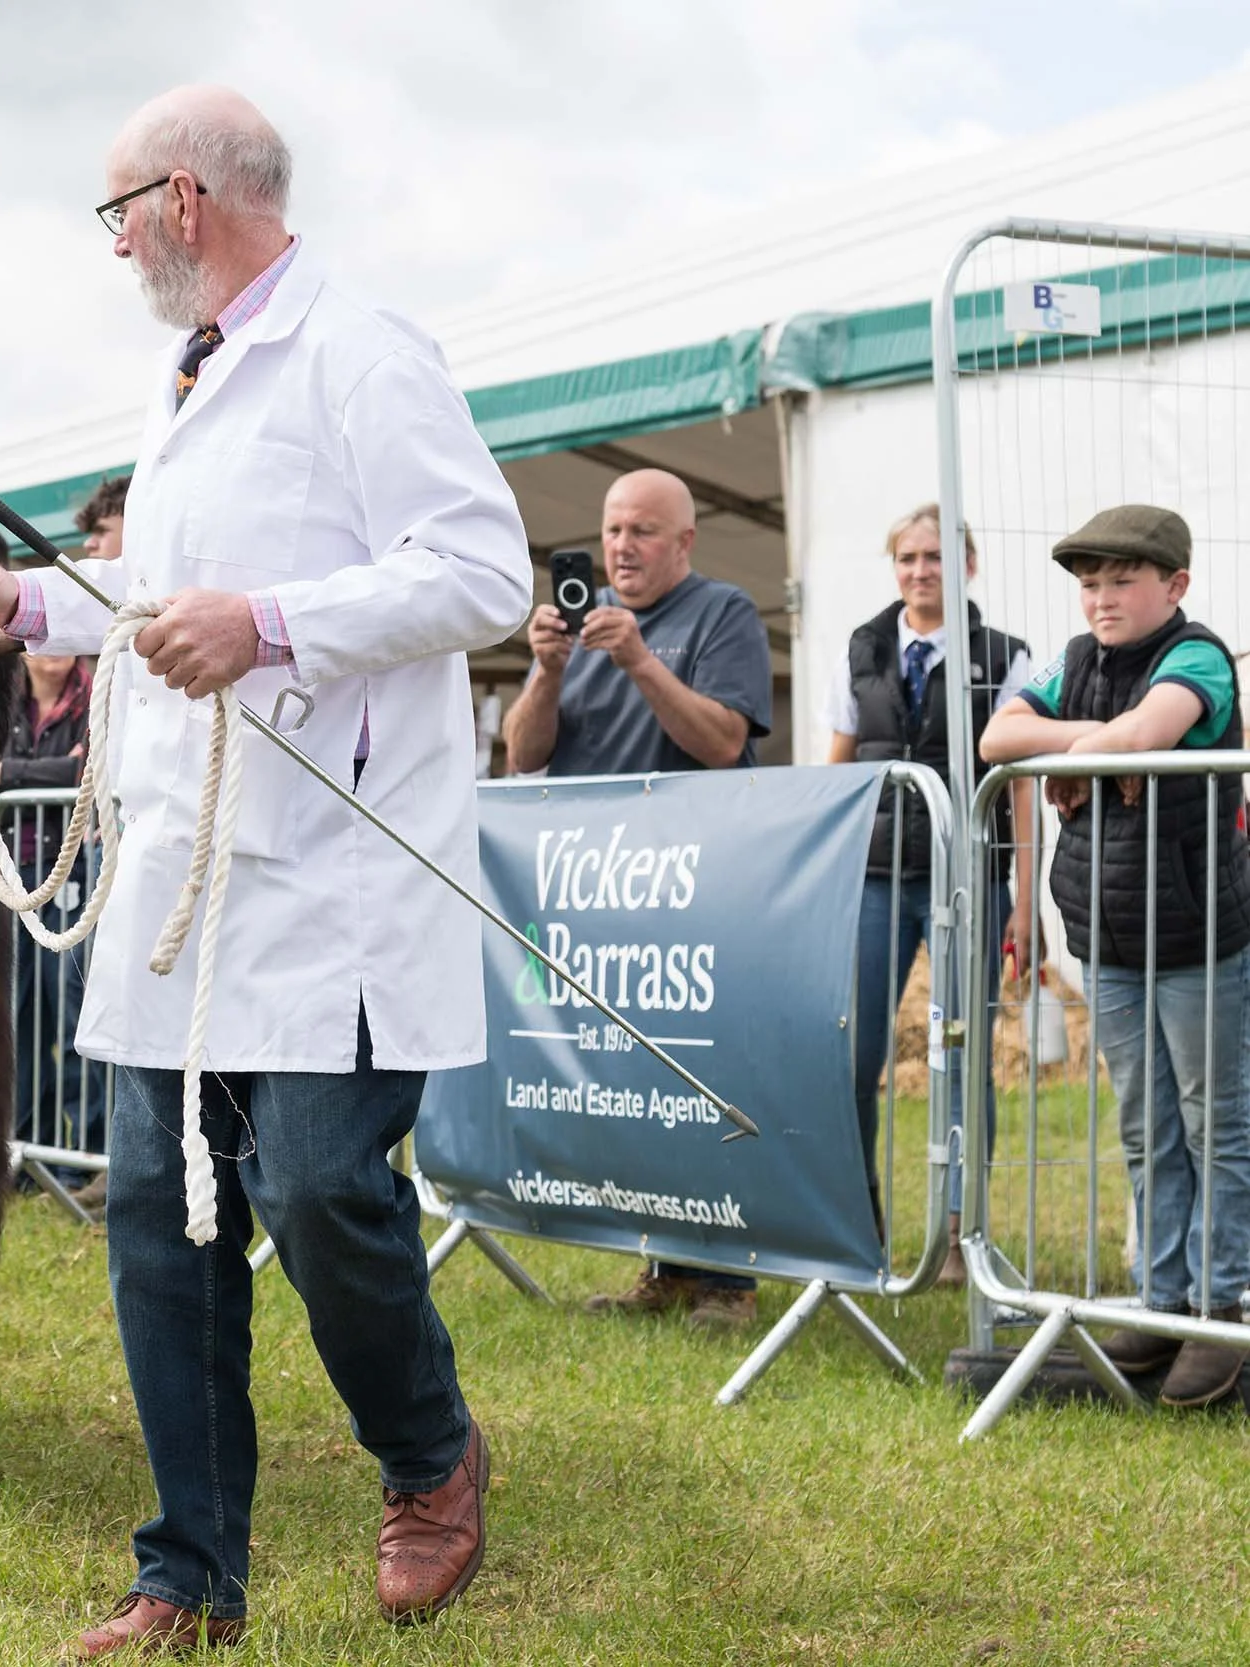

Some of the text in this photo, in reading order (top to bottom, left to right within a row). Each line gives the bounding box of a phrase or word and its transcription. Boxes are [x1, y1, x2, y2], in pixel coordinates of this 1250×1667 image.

[536, 823, 700, 911] Vickers
[578, 1022, 601, 1051] Est.
[506, 1076, 720, 1128] Land and Estate Agents
[507, 1169, 748, 1229] vickersandbarrass.co.uk
